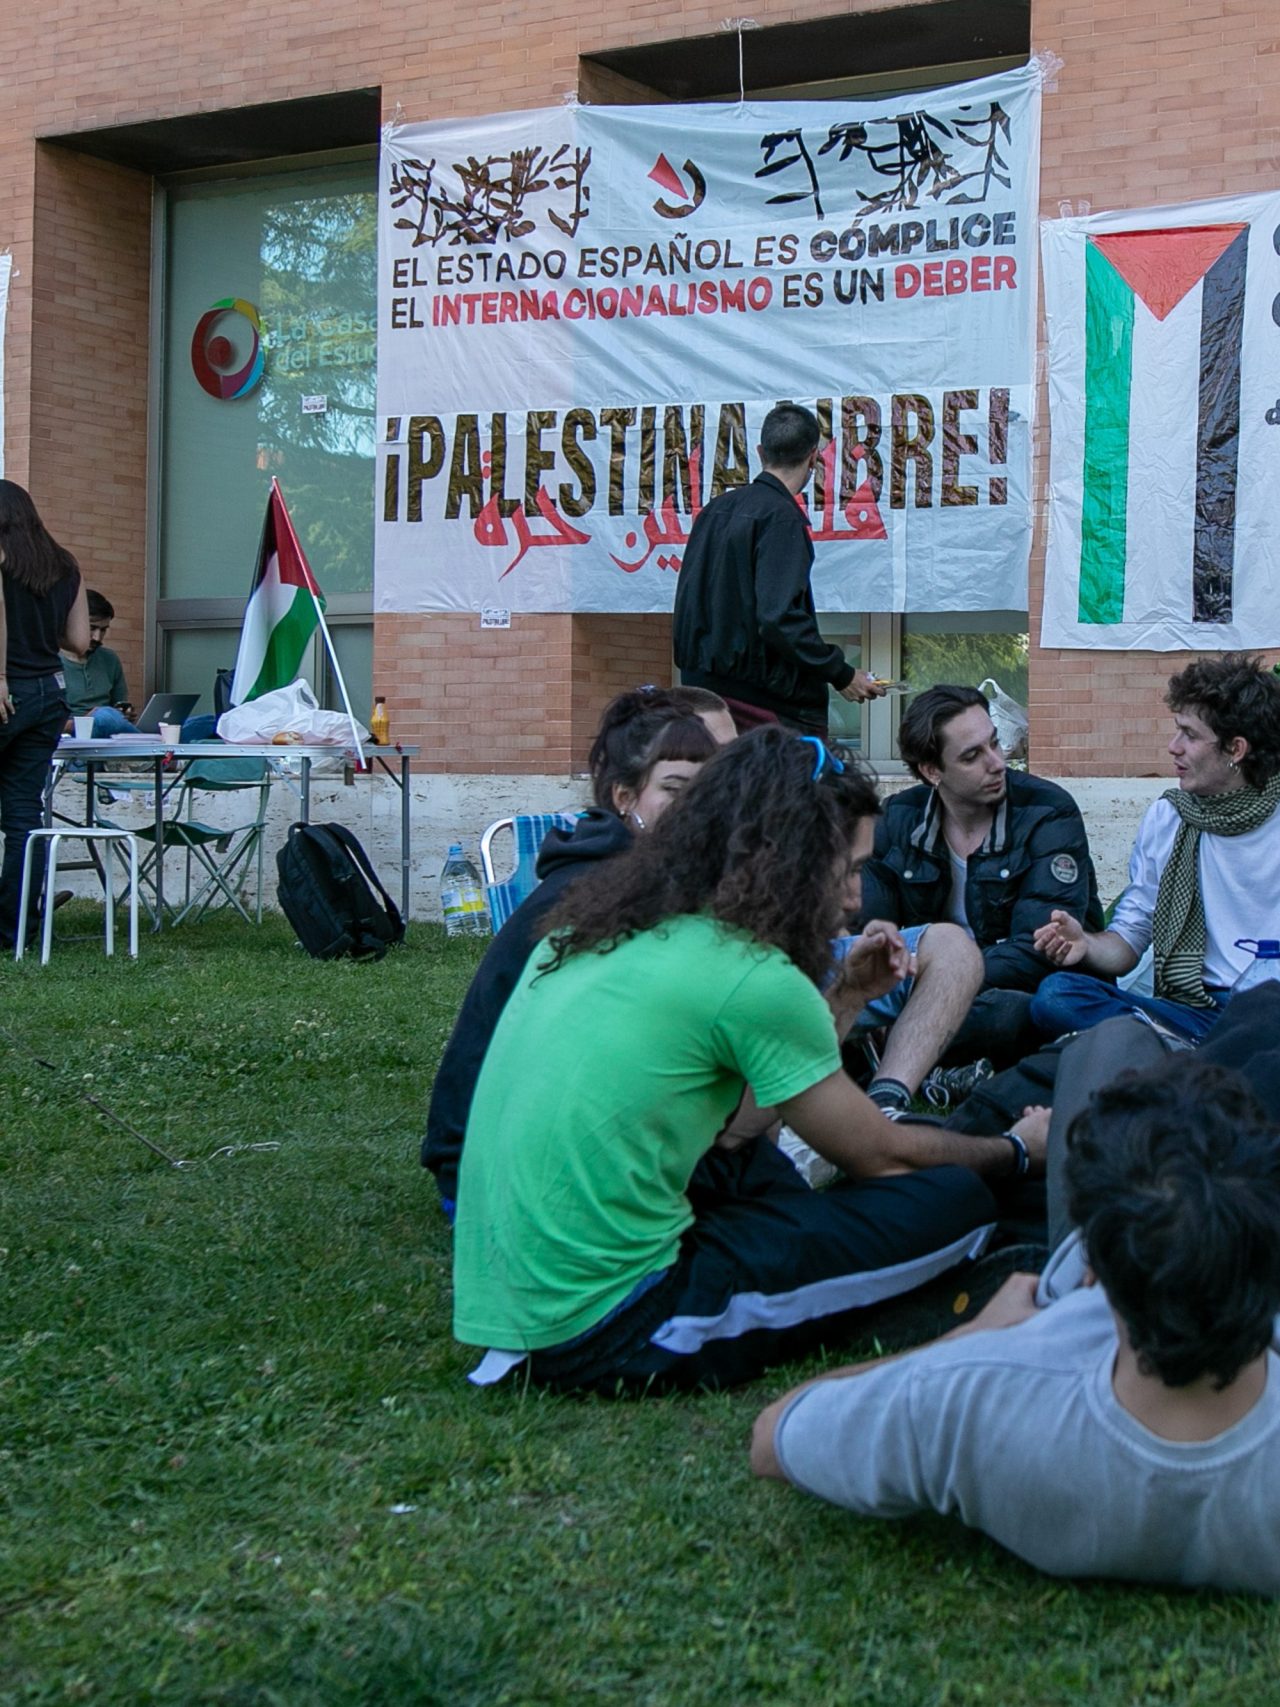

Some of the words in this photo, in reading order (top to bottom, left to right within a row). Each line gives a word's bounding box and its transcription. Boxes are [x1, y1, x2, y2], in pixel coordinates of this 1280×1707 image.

[391, 296, 425, 329] EL
[432, 276, 772, 327] INTERNACIONALISMO
[783, 271, 824, 308] ES
[833, 267, 885, 305] UN
[894, 255, 1018, 300] DEBER
[392, 257, 428, 289] EL
[436, 249, 567, 287] ESTADO
[577, 232, 744, 279] ESPAÑOL
[753, 233, 800, 267] ES
[809, 211, 1017, 263] CÓMPLICE
[384, 404, 749, 522] ¡PALESTINA
[776, 388, 1010, 512] IBRE!
[473, 449, 592, 583] حرة
